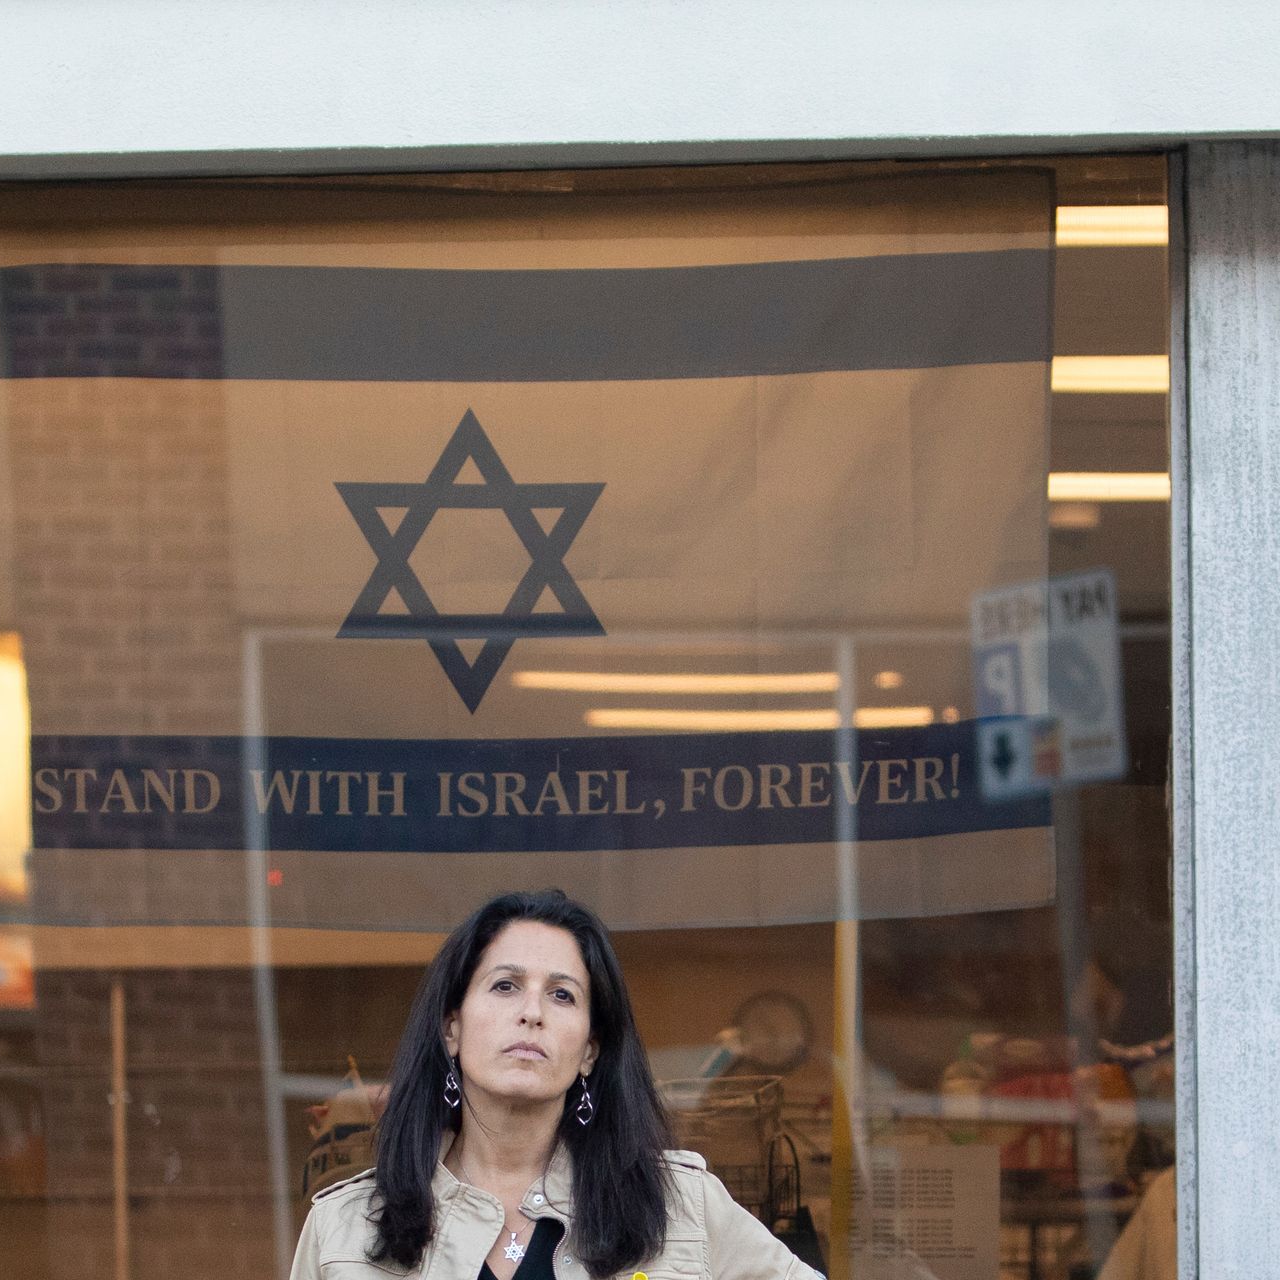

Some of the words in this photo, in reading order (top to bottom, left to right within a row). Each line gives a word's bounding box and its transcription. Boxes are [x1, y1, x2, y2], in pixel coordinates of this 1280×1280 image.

[33, 768, 220, 815] STAND
[250, 770, 408, 818] WITH
[436, 771, 667, 820] ISRAEL,
[680, 752, 961, 813] FOREVER!
